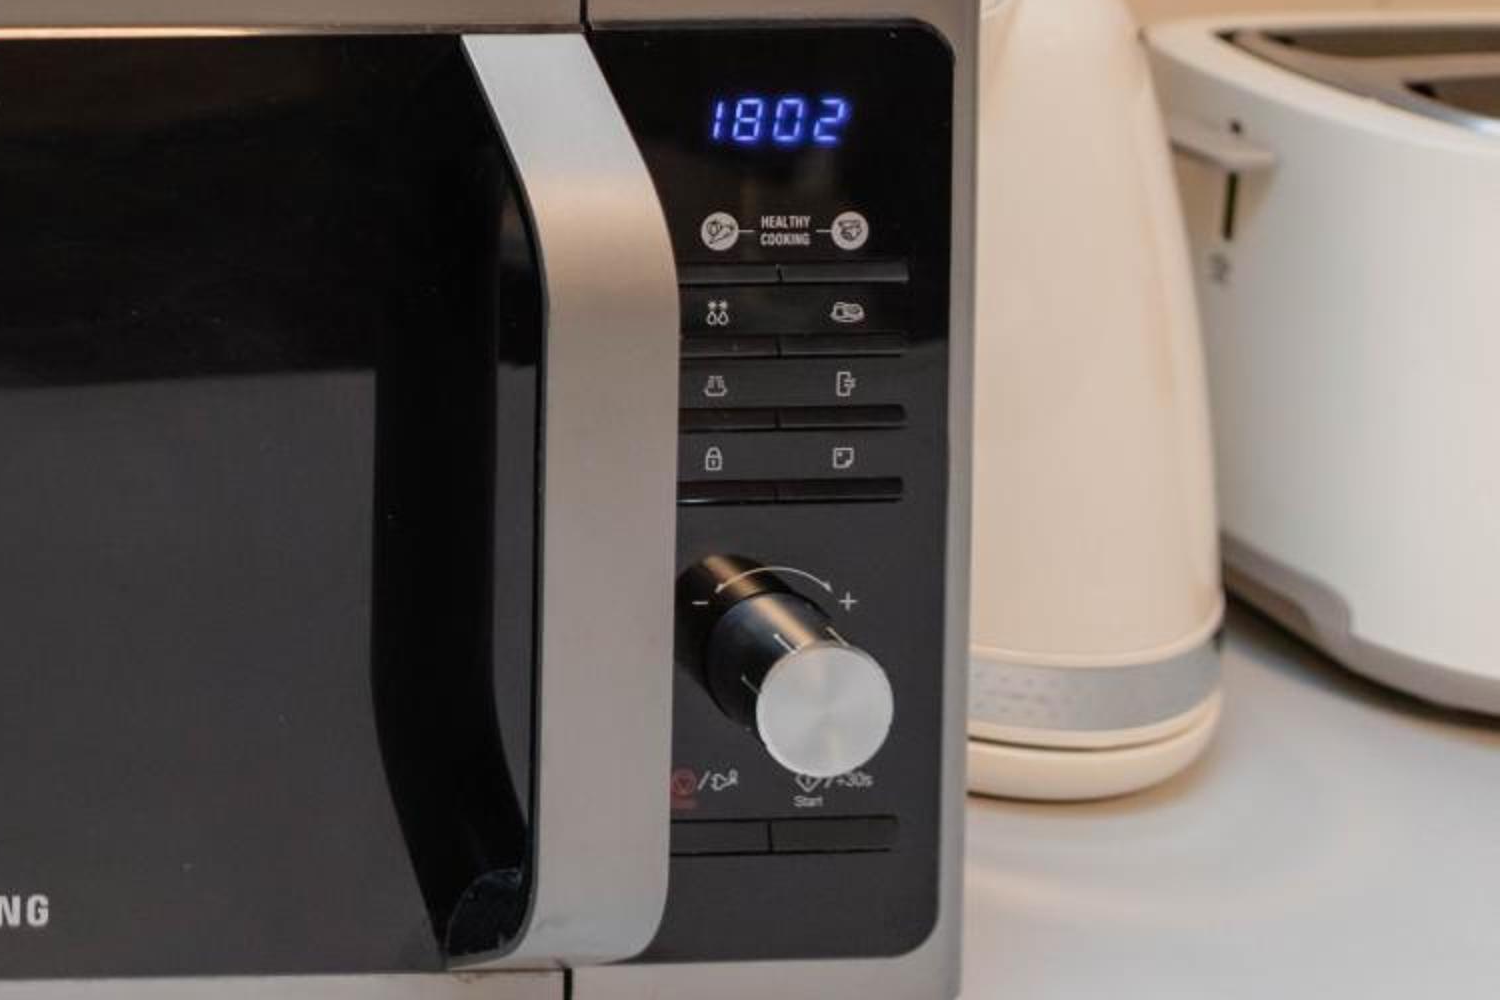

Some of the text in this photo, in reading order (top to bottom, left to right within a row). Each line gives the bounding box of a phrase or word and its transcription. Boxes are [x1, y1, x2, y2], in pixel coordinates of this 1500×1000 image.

[712, 98, 848, 142] 1802
[760, 215, 811, 229] HEALTHY
[760, 232, 811, 247] COOKING
[794, 795, 823, 808] Start
